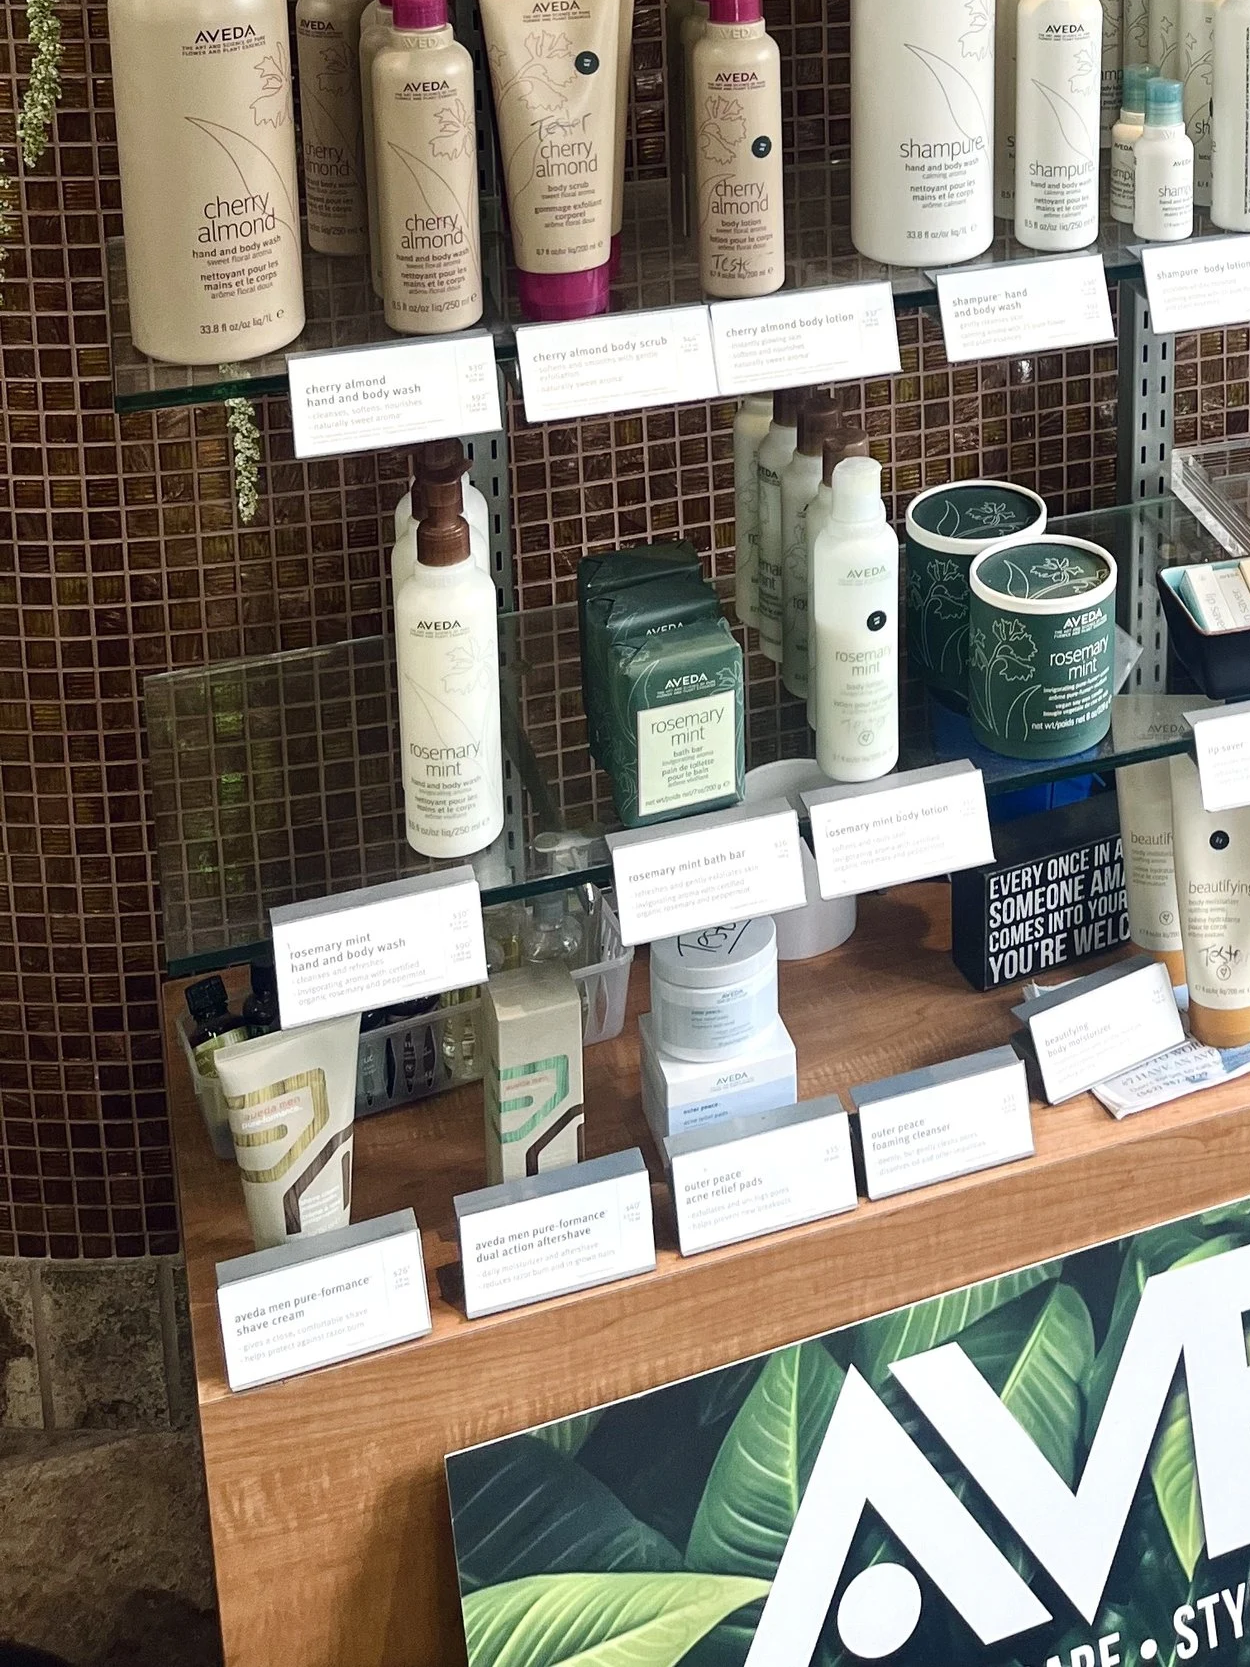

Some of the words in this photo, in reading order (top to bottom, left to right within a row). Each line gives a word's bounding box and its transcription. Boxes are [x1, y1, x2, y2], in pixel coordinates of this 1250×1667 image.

[532, 0, 581, 14] AVEDA
[540, 140, 593, 163] cherry
[900, 135, 985, 161] shampure
[535, 156, 598, 179] almond
[404, 211, 460, 235] cherry
[191, 249, 218, 260] hand
[219, 247, 237, 258] and
[239, 243, 260, 257] body
[262, 234, 281, 251] wash
[400, 229, 464, 251] almond
[1203, 263, 1223, 274] body
[533, 349, 565, 364] cherry
[567, 346, 602, 359] almond
[605, 340, 636, 356] body
[639, 336, 668, 349] scrub
[306, 396, 332, 408] hand
[335, 392, 355, 404] and
[357, 389, 389, 404] body
[393, 383, 421, 396] wash
[1049, 639, 1110, 667] rosemary
[1068, 658, 1098, 679] mint
[650, 705, 726, 735] rosemary
[670, 728, 707, 745] mint
[409, 739, 481, 763] rosemary
[425, 760, 463, 779] mint
[628, 867, 673, 885] rosemary
[675, 861, 700, 875] mint
[704, 855, 726, 869] bath
[729, 849, 747, 862] bar
[990, 863, 1043, 900] EVERY
[1047, 849, 1090, 881] ONCE
[1094, 842, 1110, 866] IN
[989, 874, 1085, 928] SOMEONE
[989, 917, 1044, 953] COMES
[1049, 904, 1083, 934] INTO
[1088, 890, 1127, 920] YOUR
[289, 942, 342, 961] rosemary
[345, 932, 372, 946] mint
[290, 961, 319, 973] hand
[321, 954, 343, 968] and
[345, 948, 375, 966] body
[377, 937, 407, 952] wash
[988, 933, 1068, 984] YOU'RE
[872, 1135, 908, 1153] foaming
[910, 1123, 951, 1144] cleanser
[684, 1178, 710, 1194] outer
[713, 1169, 742, 1188] peace
[476, 1250, 499, 1263] dual
[501, 1240, 535, 1257] action
[537, 1226, 591, 1251] aftershave
[235, 1304, 267, 1323] aveda
[269, 1296, 291, 1311] men
[236, 1316, 270, 1337] shave
[272, 1307, 305, 1325] cream
